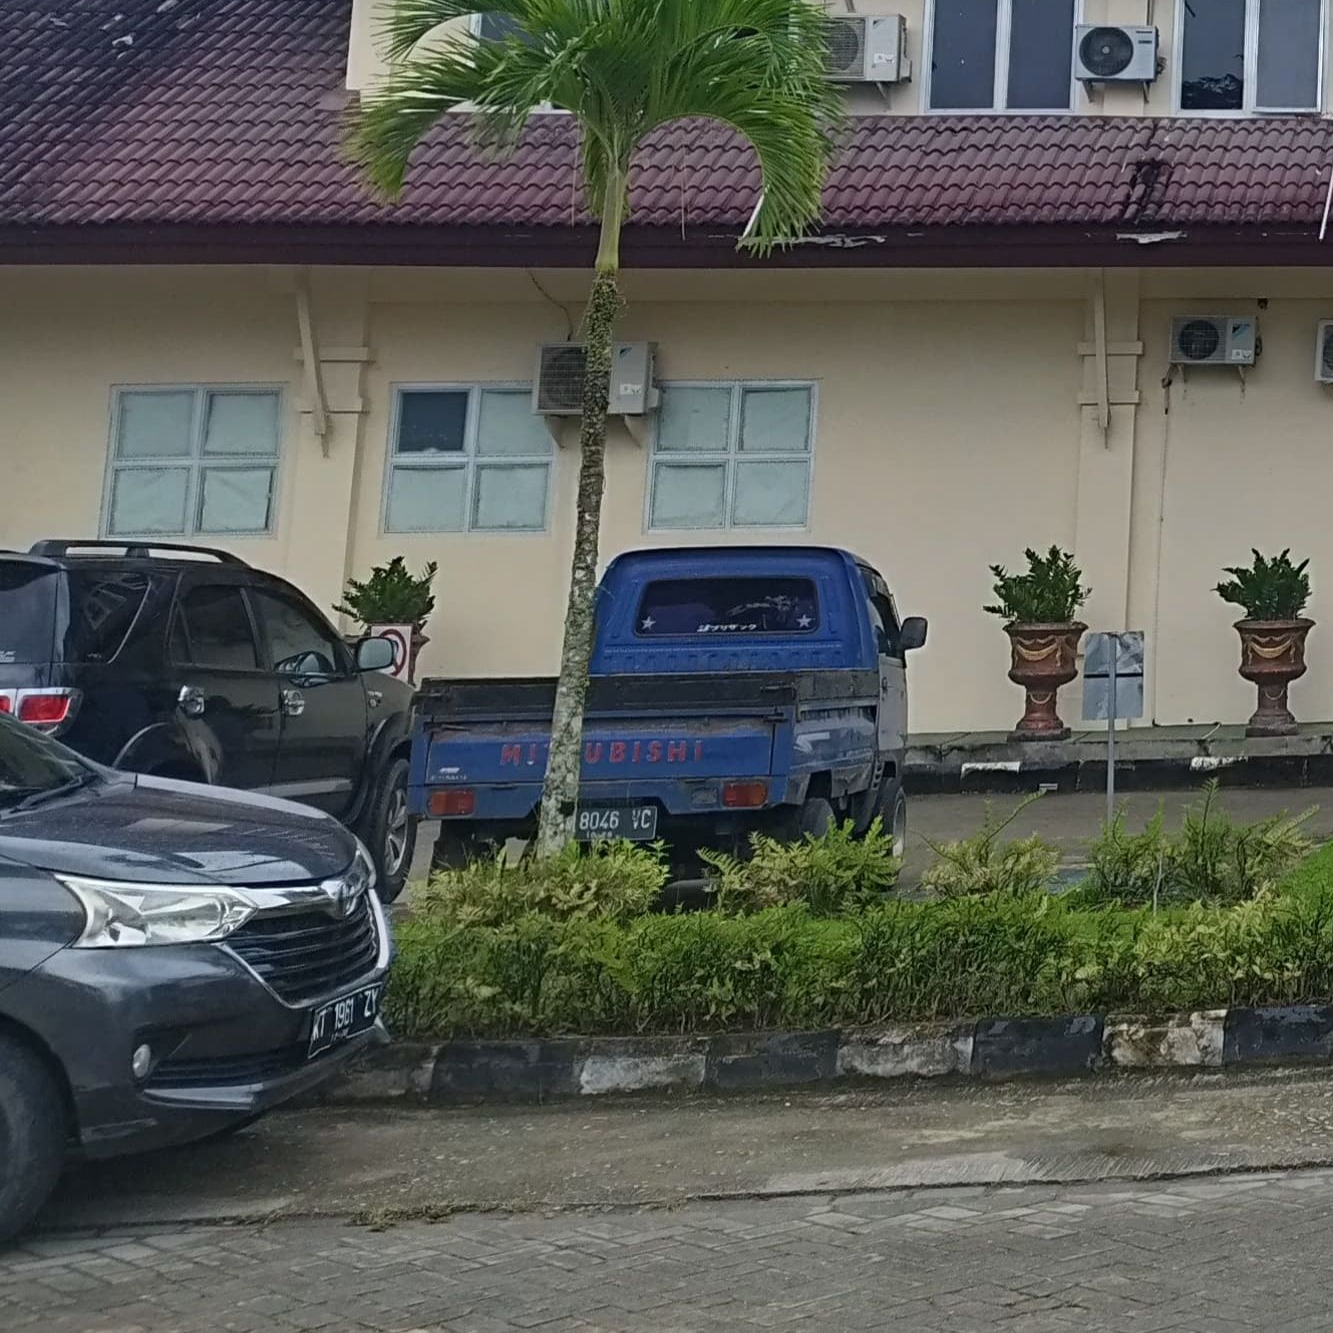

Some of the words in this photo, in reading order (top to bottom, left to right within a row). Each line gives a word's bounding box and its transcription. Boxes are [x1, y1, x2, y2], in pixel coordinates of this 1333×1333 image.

[501, 740, 702, 765] MIUBISHI
[580, 810, 619, 830] 8046
[313, 1009, 327, 1041] KT
